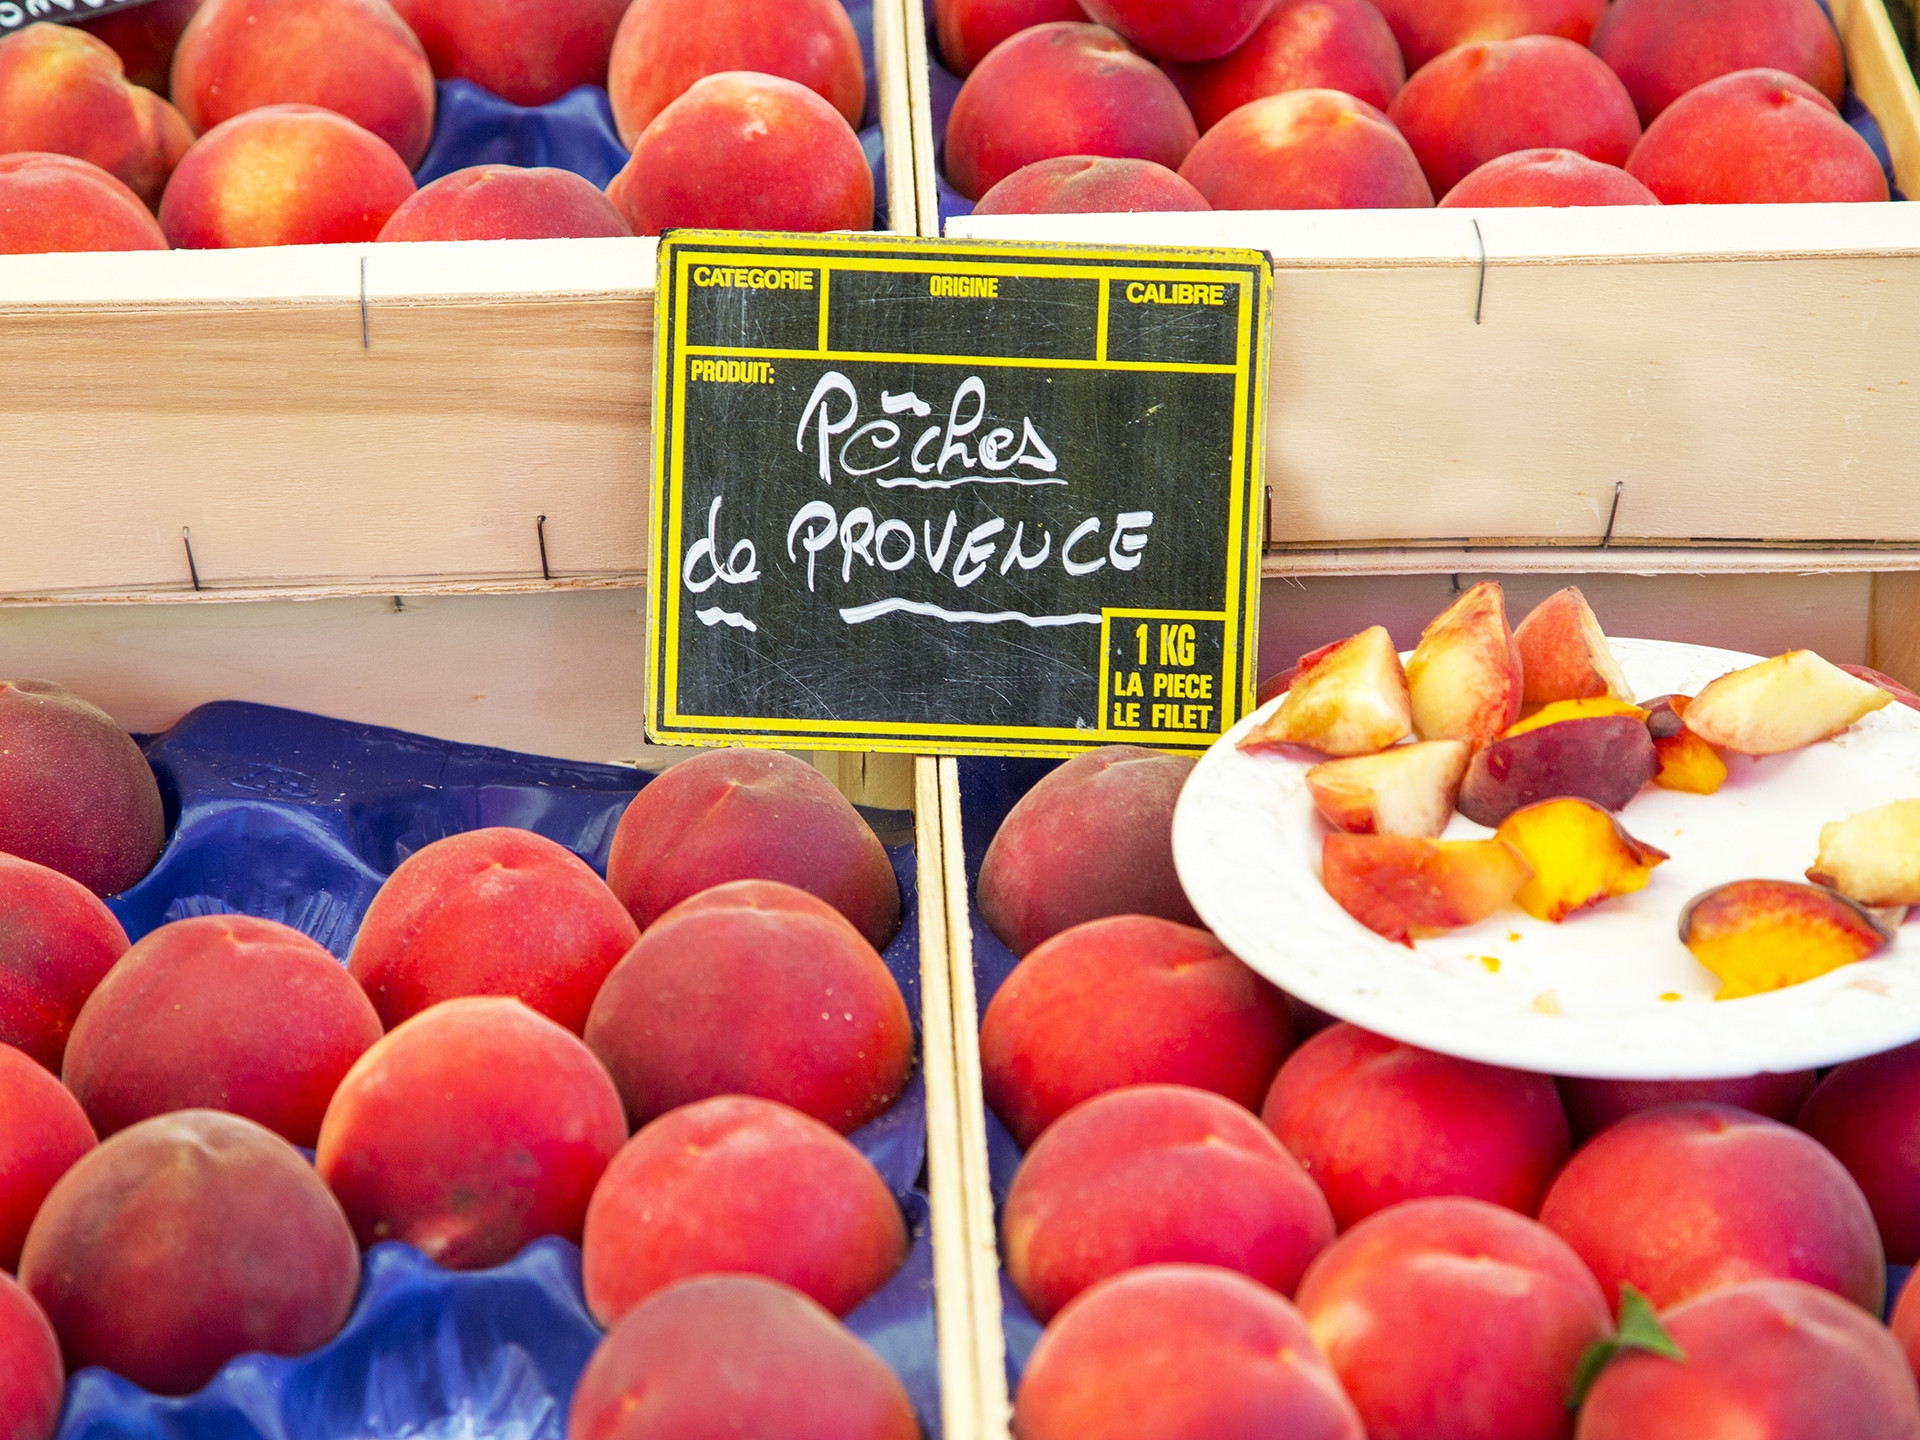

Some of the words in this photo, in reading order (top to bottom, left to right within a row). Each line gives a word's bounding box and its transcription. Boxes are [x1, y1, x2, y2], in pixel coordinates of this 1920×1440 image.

[693, 266, 814, 291] CATEGORIE
[930, 274, 998, 299] ORIGINE
[1126, 281, 1225, 306] CALIBRE
[690, 359, 776, 385] PRODUIT:
[683, 495, 762, 593] de
[787, 499, 1154, 592] PROVENCE
[1135, 623, 1148, 665] 1
[1159, 623, 1196, 667] KG
[1114, 671, 1144, 697] LA
[1153, 672, 1213, 699] PIECE
[1113, 702, 1141, 728] LE
[1151, 703, 1214, 730] FILET
